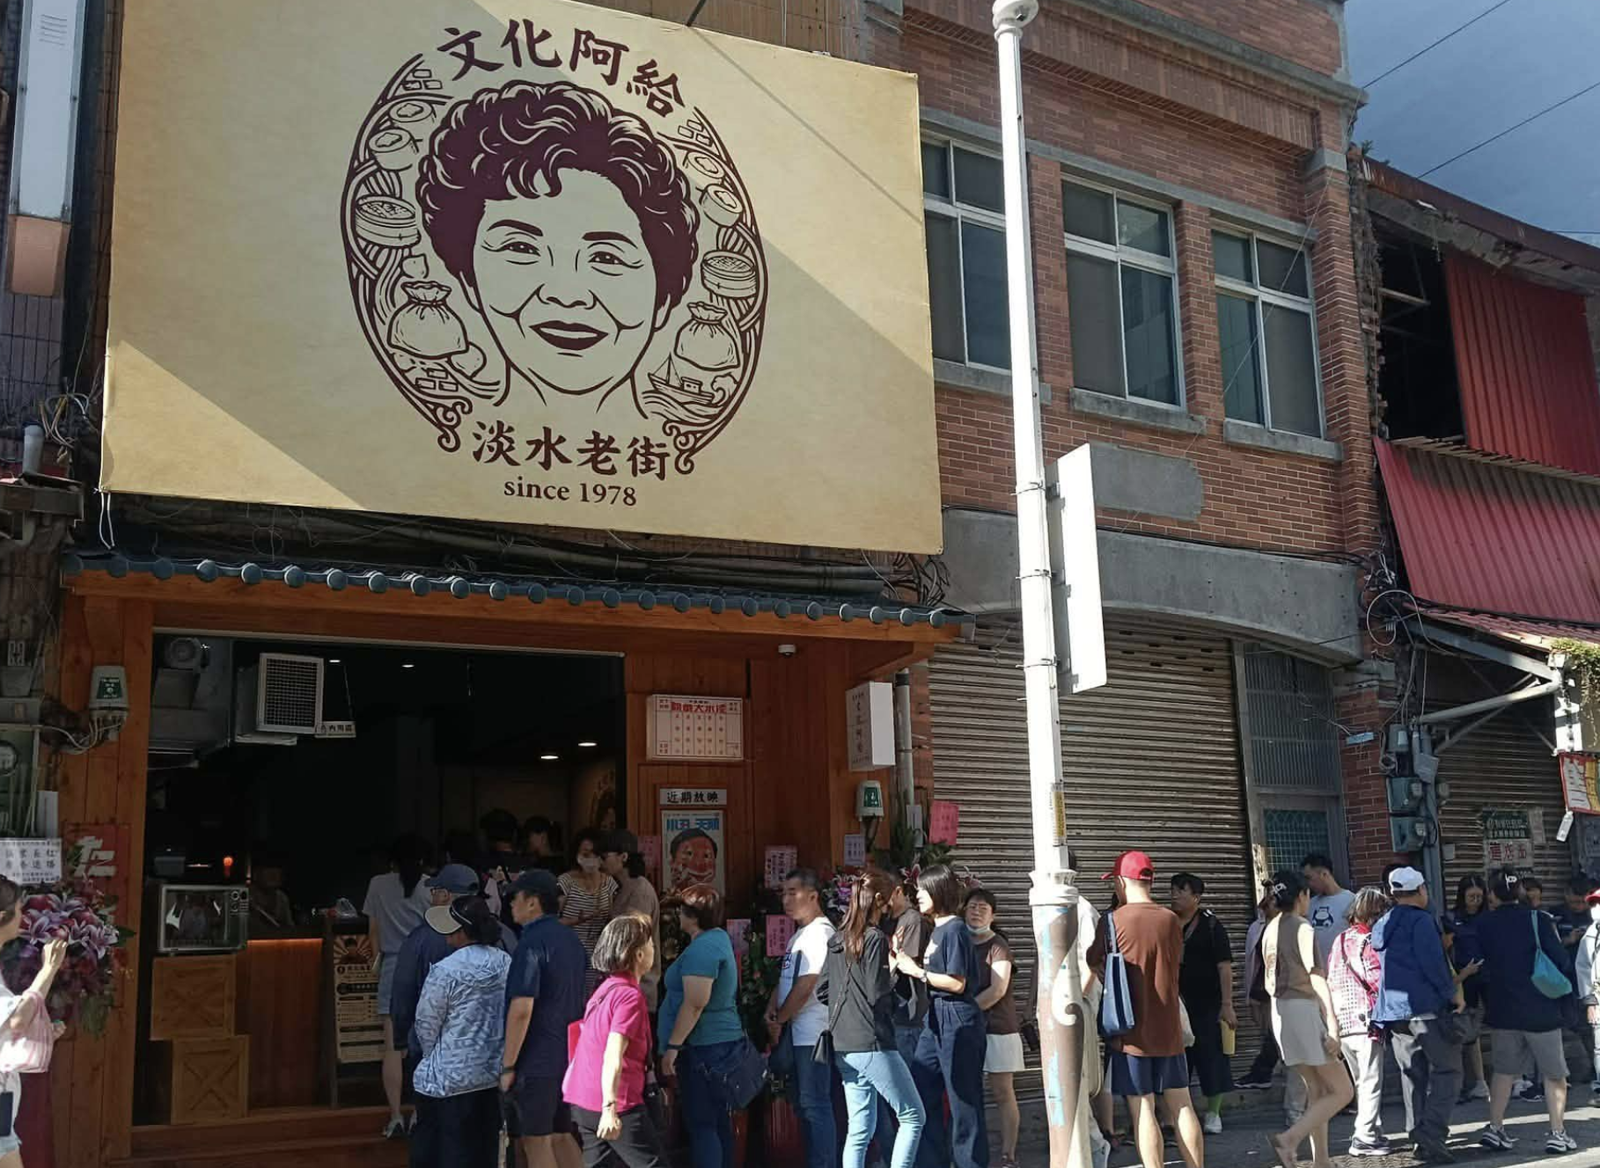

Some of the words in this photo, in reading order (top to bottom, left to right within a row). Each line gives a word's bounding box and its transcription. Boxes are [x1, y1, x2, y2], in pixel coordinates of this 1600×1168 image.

[437, 19, 684, 118] 文化阿給
[472, 419, 671, 481] 淡水老街
[503, 478, 570, 501] since
[580, 483, 637, 507] 1978
[667, 791, 719, 804] 近期放映
